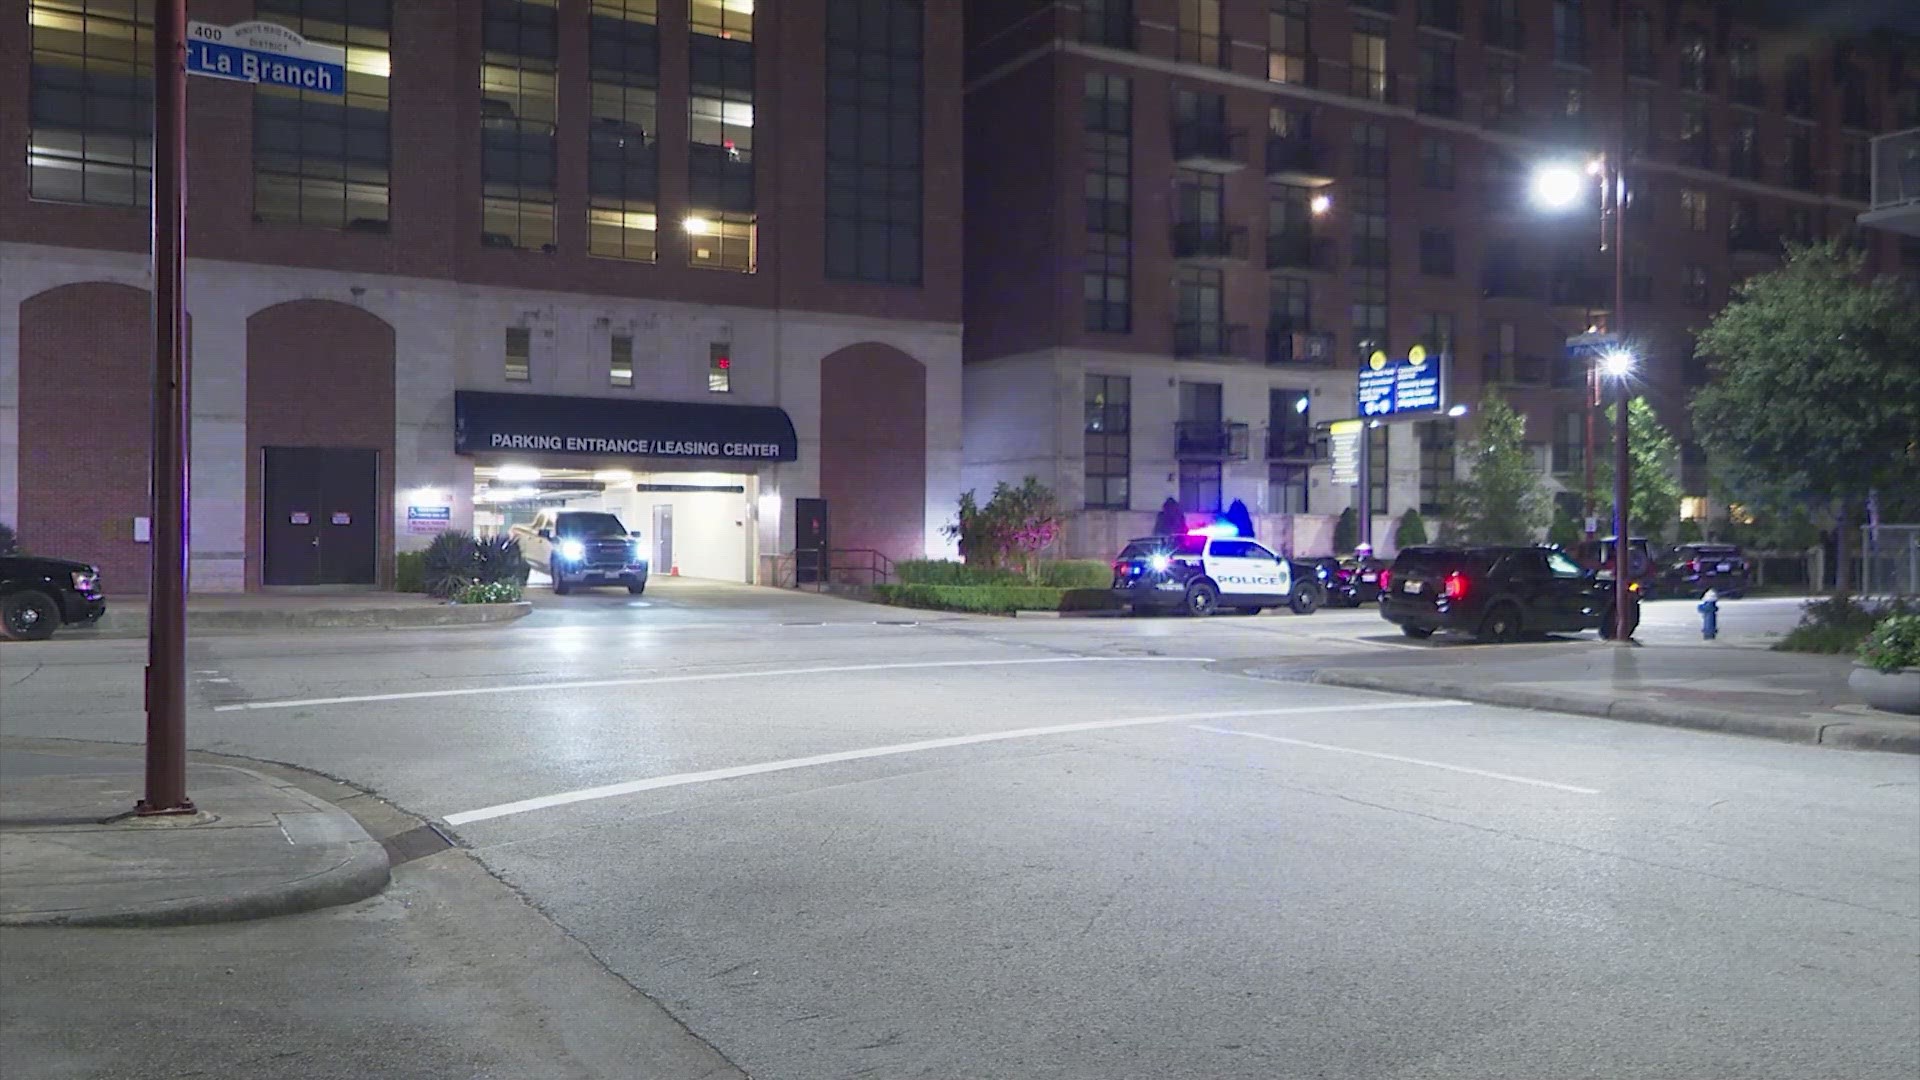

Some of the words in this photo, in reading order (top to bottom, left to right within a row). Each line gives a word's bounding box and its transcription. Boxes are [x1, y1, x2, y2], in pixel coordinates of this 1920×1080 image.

[194, 26, 222, 41] 400
[283, 31, 302, 46] PARK
[249, 38, 288, 51] DISTRICT
[201, 46, 232, 74] La
[242, 51, 332, 90] Branch
[491, 433, 562, 450] PARKING
[722, 442, 780, 457] CENTER
[1217, 575, 1280, 586] POLICE
